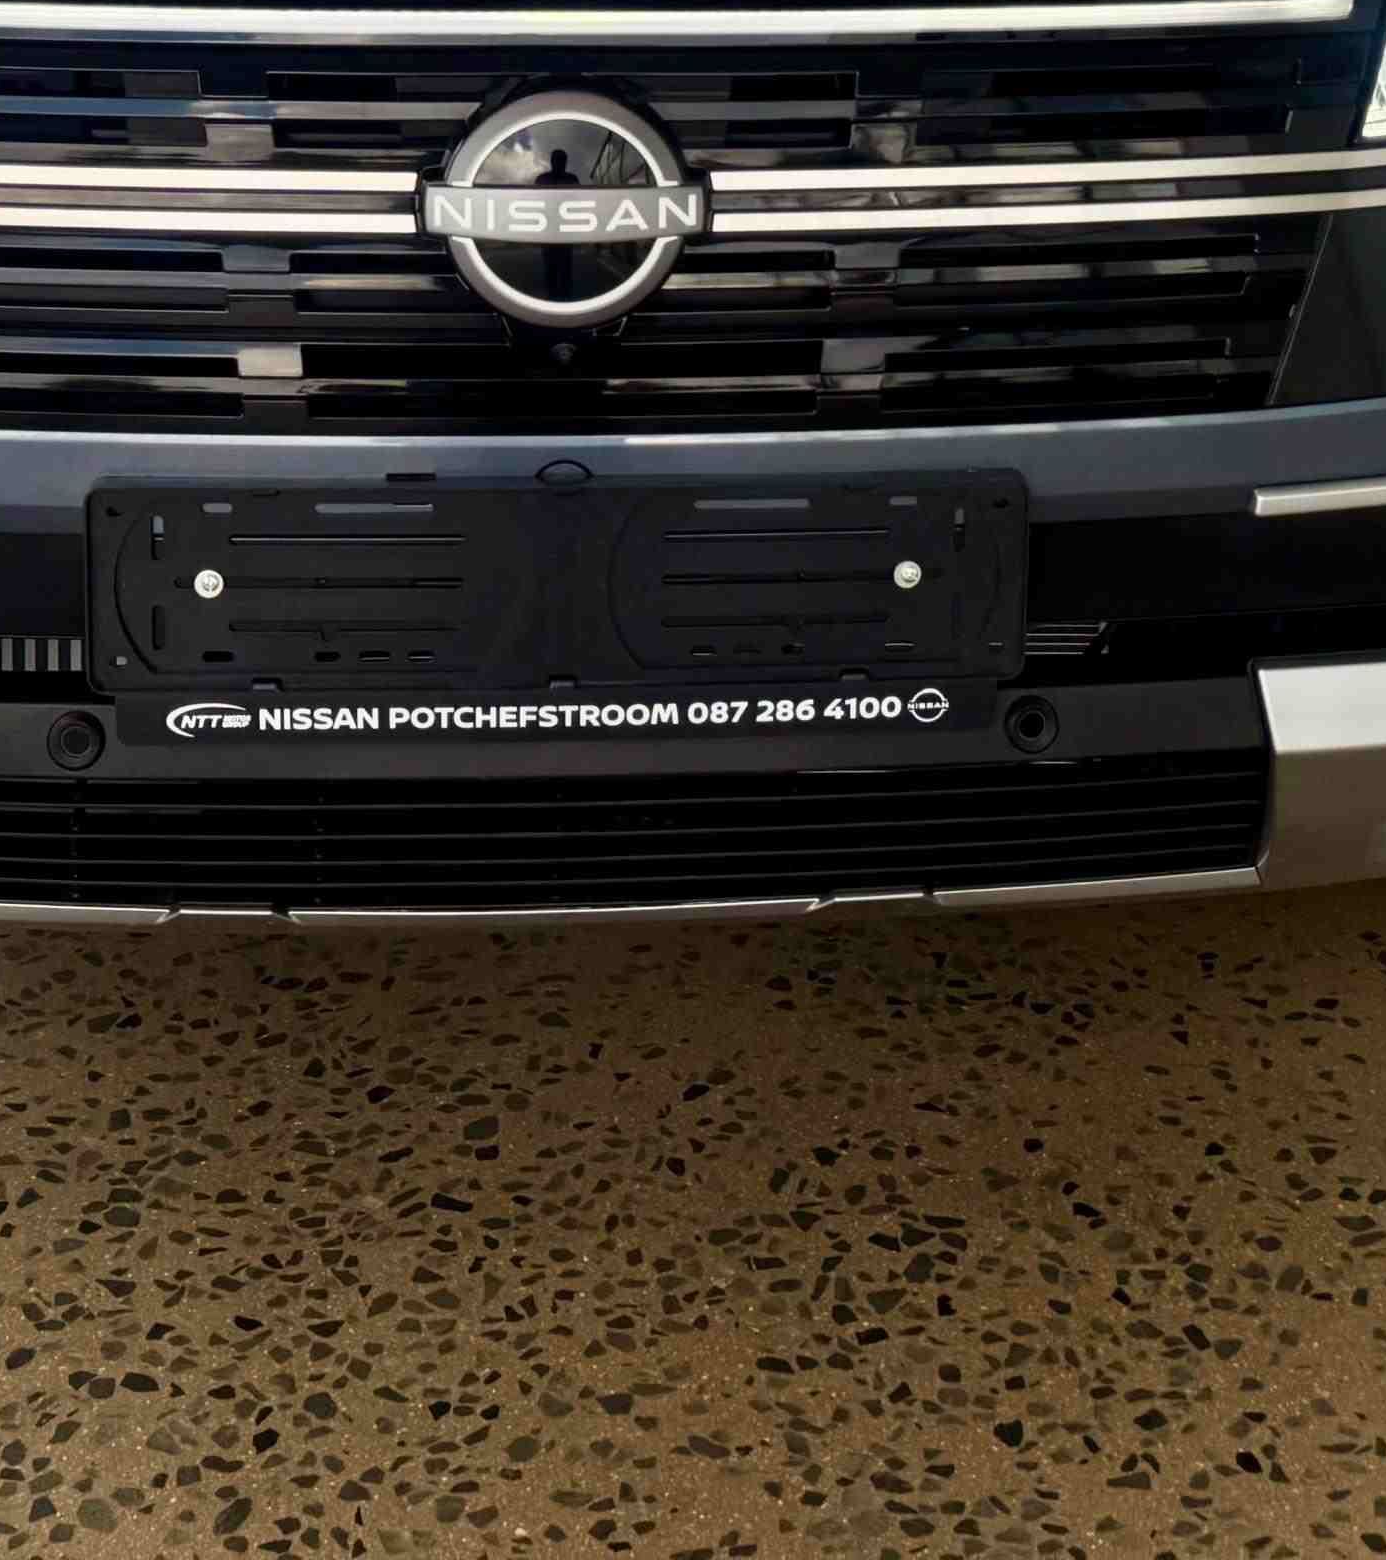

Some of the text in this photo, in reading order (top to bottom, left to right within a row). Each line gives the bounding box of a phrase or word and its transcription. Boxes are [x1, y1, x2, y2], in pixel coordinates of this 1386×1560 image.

[433, 193, 697, 232] NISSAN
[180, 714, 222, 729] NTT
[258, 707, 380, 730] NISSAN
[389, 703, 679, 729] POTCHEFSTROOM
[687, 701, 748, 724] 087
[756, 699, 816, 723] 286
[823, 696, 902, 719] 4100
[907, 700, 950, 711] NISSAN
